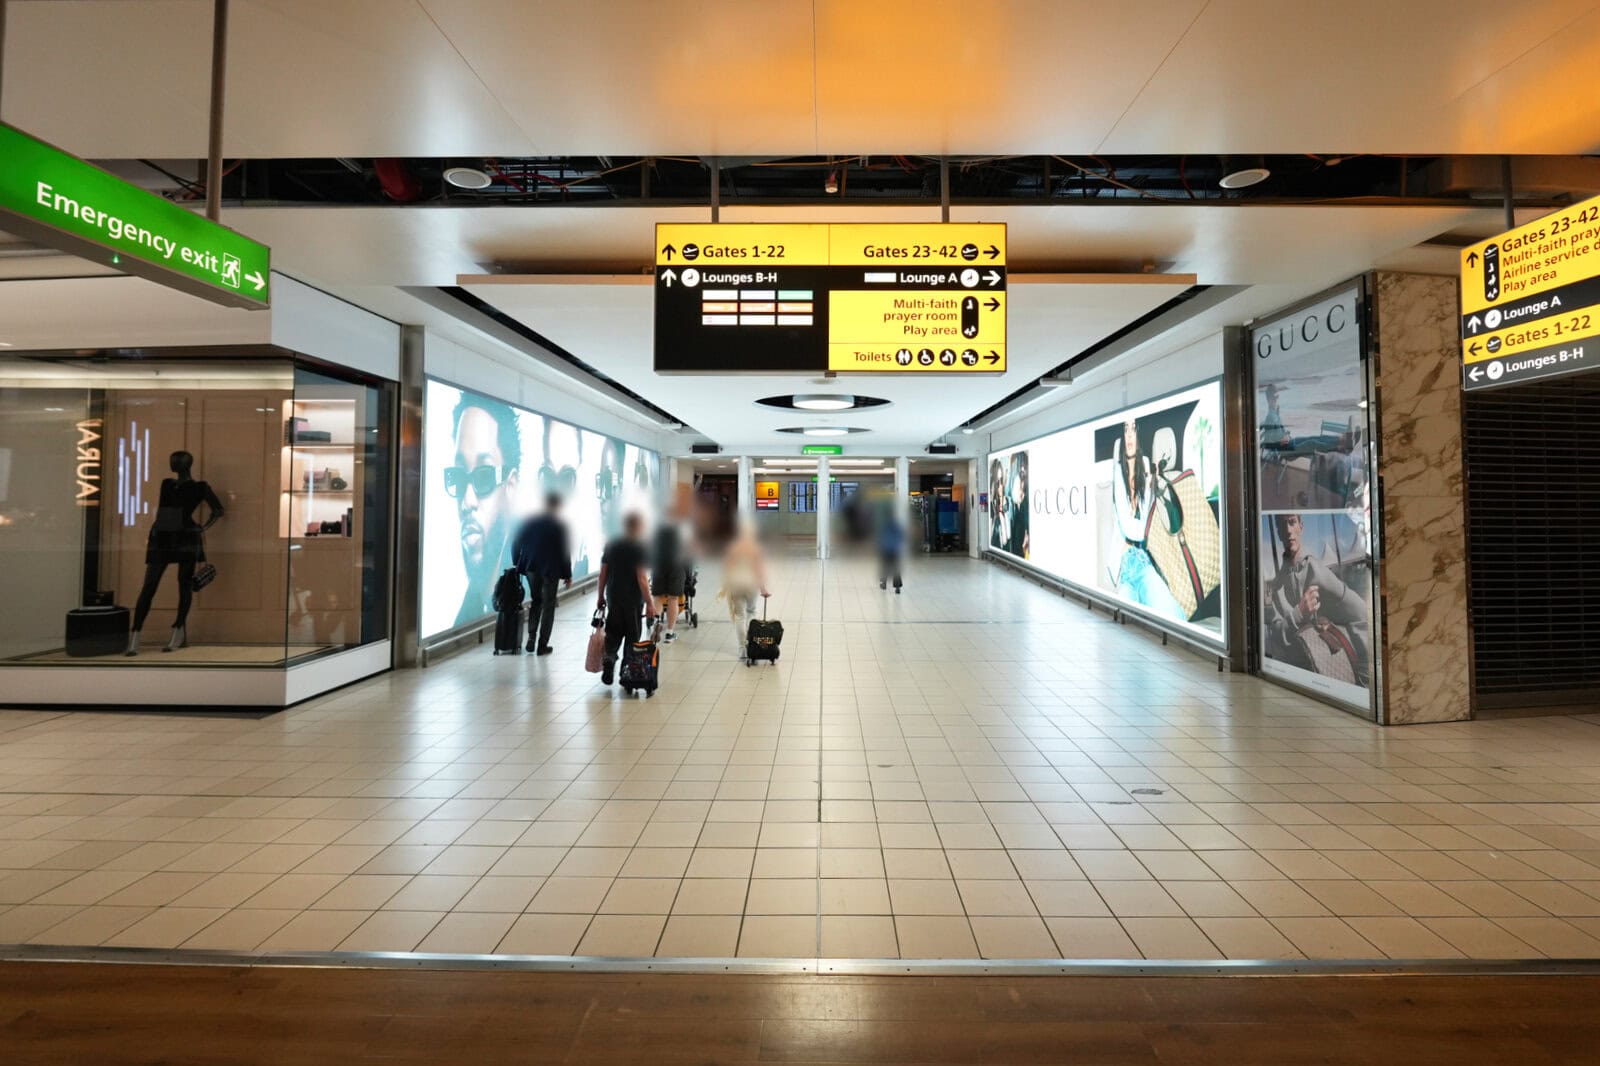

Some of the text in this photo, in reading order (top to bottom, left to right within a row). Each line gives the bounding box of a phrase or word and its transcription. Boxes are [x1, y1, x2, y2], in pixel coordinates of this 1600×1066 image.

[36, 181, 218, 273] Emergency exit
[1502, 206, 1599, 252] Gates 23-42
[703, 244, 785, 258] Gates 1-22
[863, 245, 958, 258] Gates 23-42
[1503, 237, 1567, 267] Multi-faith
[1503, 261, 1541, 280] Airline
[1544, 245, 1590, 266] service
[702, 272, 778, 285] Lounges B-H
[900, 272, 958, 285] Lounge A
[1503, 270, 1557, 293] Play area
[893, 298, 958, 309] Multi-faith
[1503, 295, 1562, 320] Lounge A
[883, 313, 958, 323] prayer room
[903, 325, 958, 337] Play area
[1505, 314, 1592, 347] Gates 1-22
[853, 351, 892, 363] Toilets
[1506, 346, 1584, 374] Lounges B-H
[768, 488, 775, 497] B
